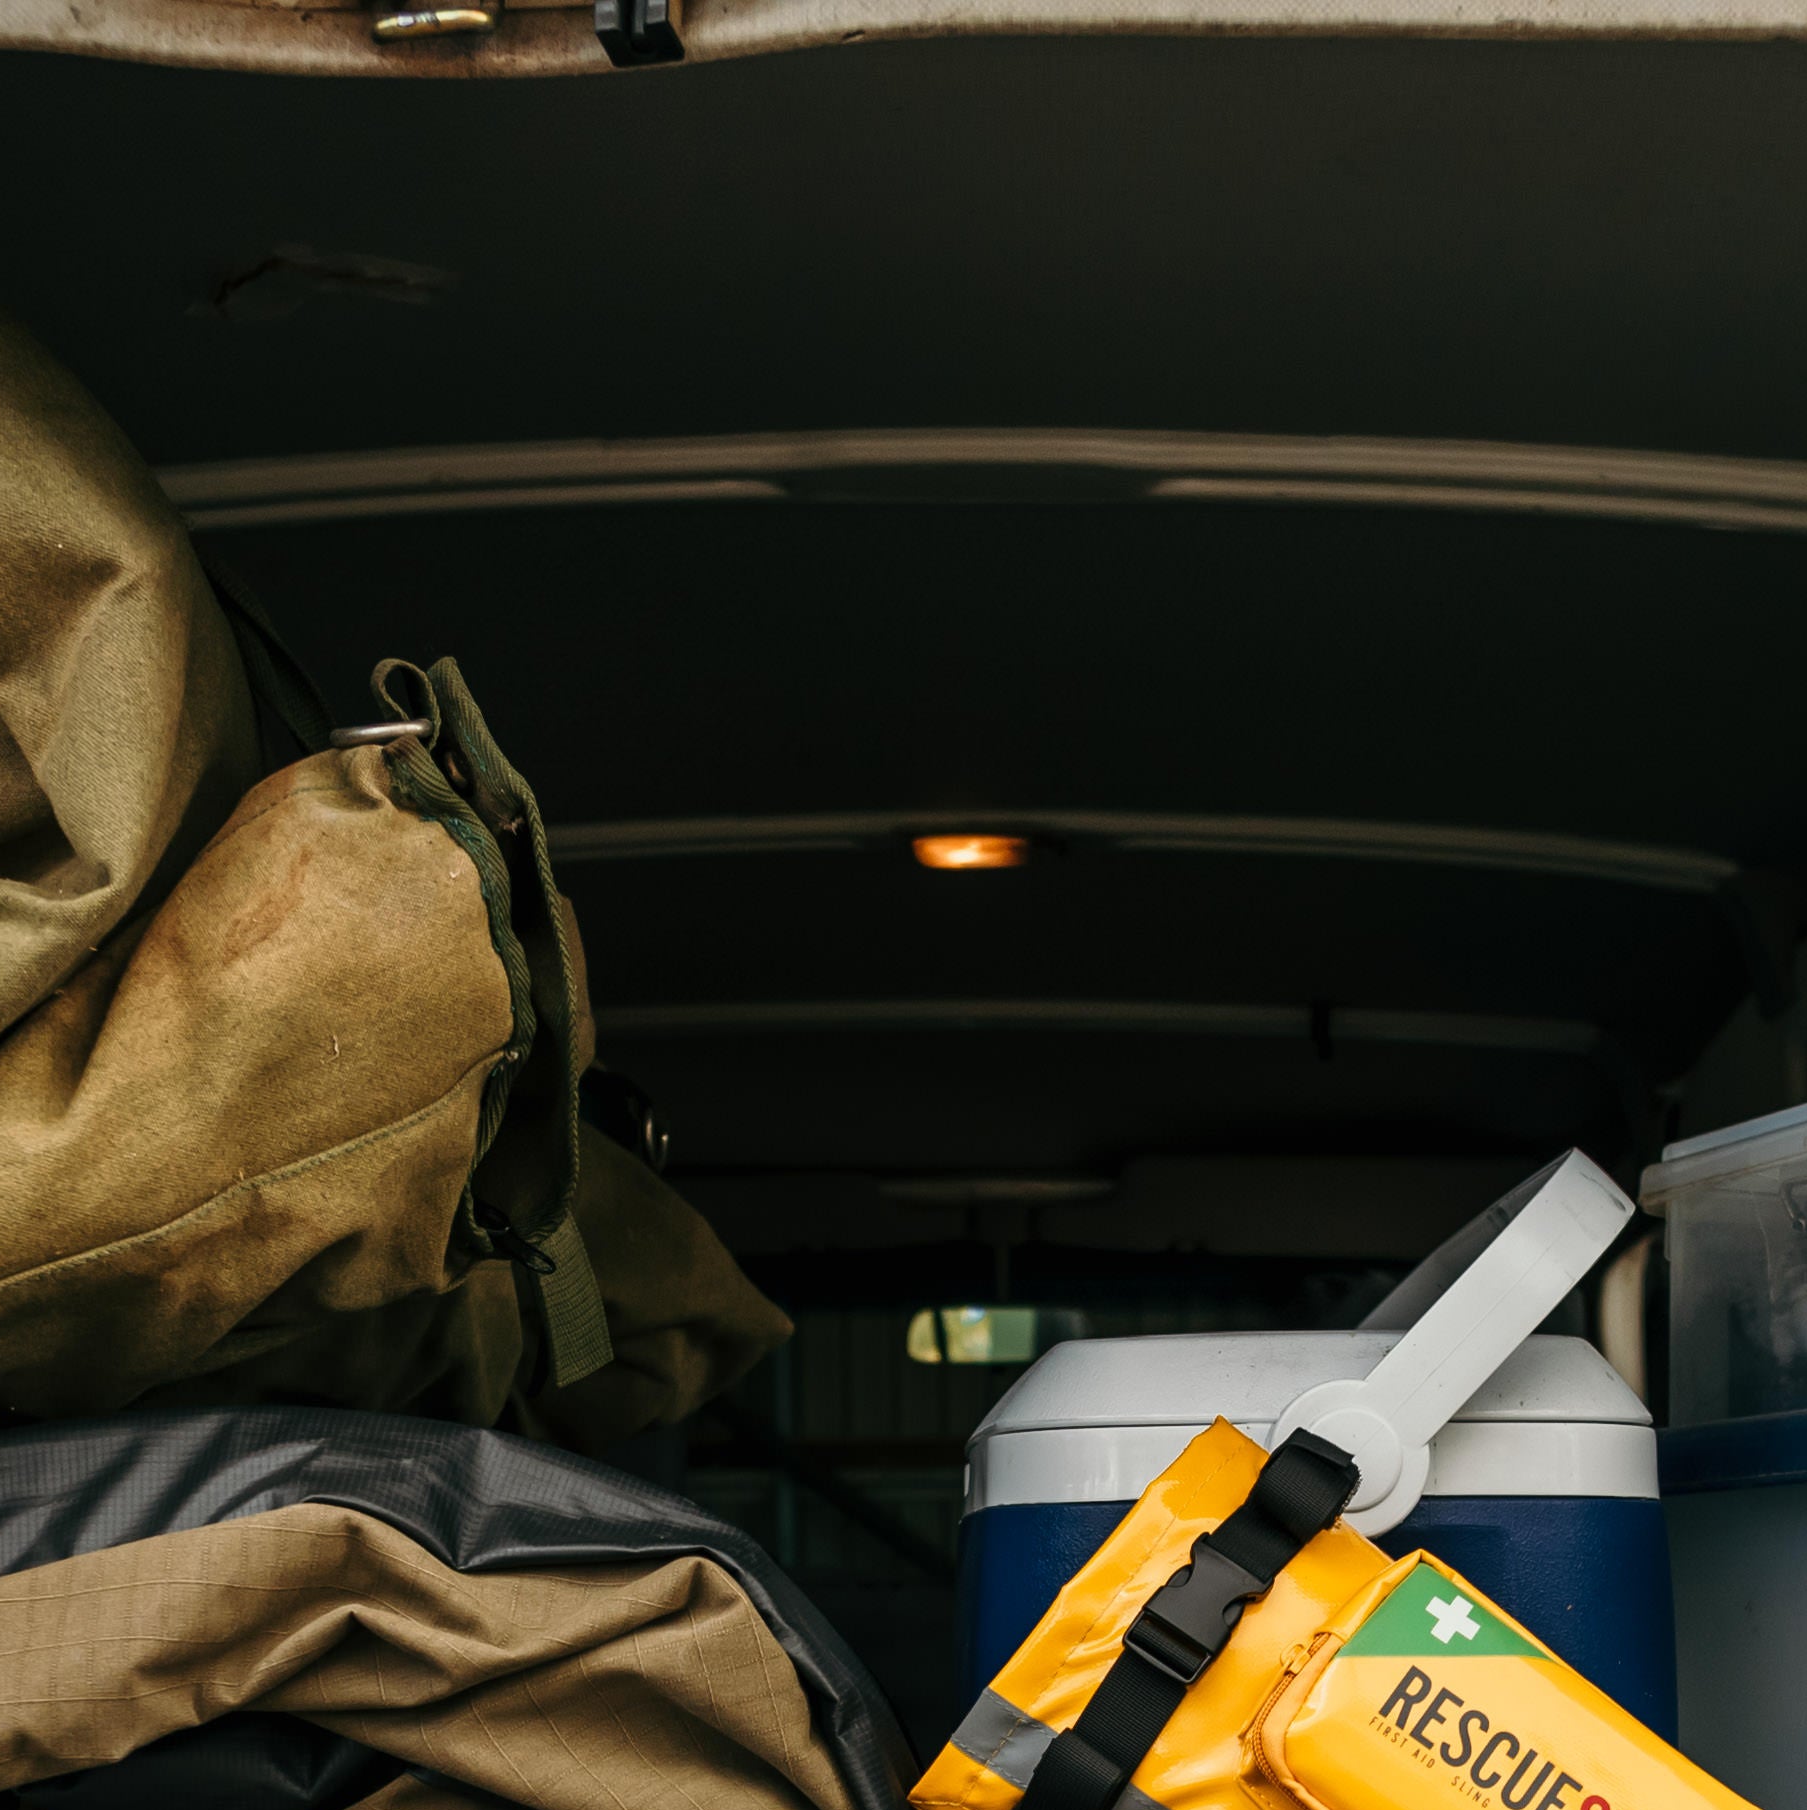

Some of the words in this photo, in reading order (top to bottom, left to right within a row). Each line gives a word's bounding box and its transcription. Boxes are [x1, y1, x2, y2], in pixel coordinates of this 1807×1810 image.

[1368, 1716, 1408, 1748] FIRST
[1411, 1749, 1436, 1769] AID
[1450, 1776, 1491, 1809] SLING
